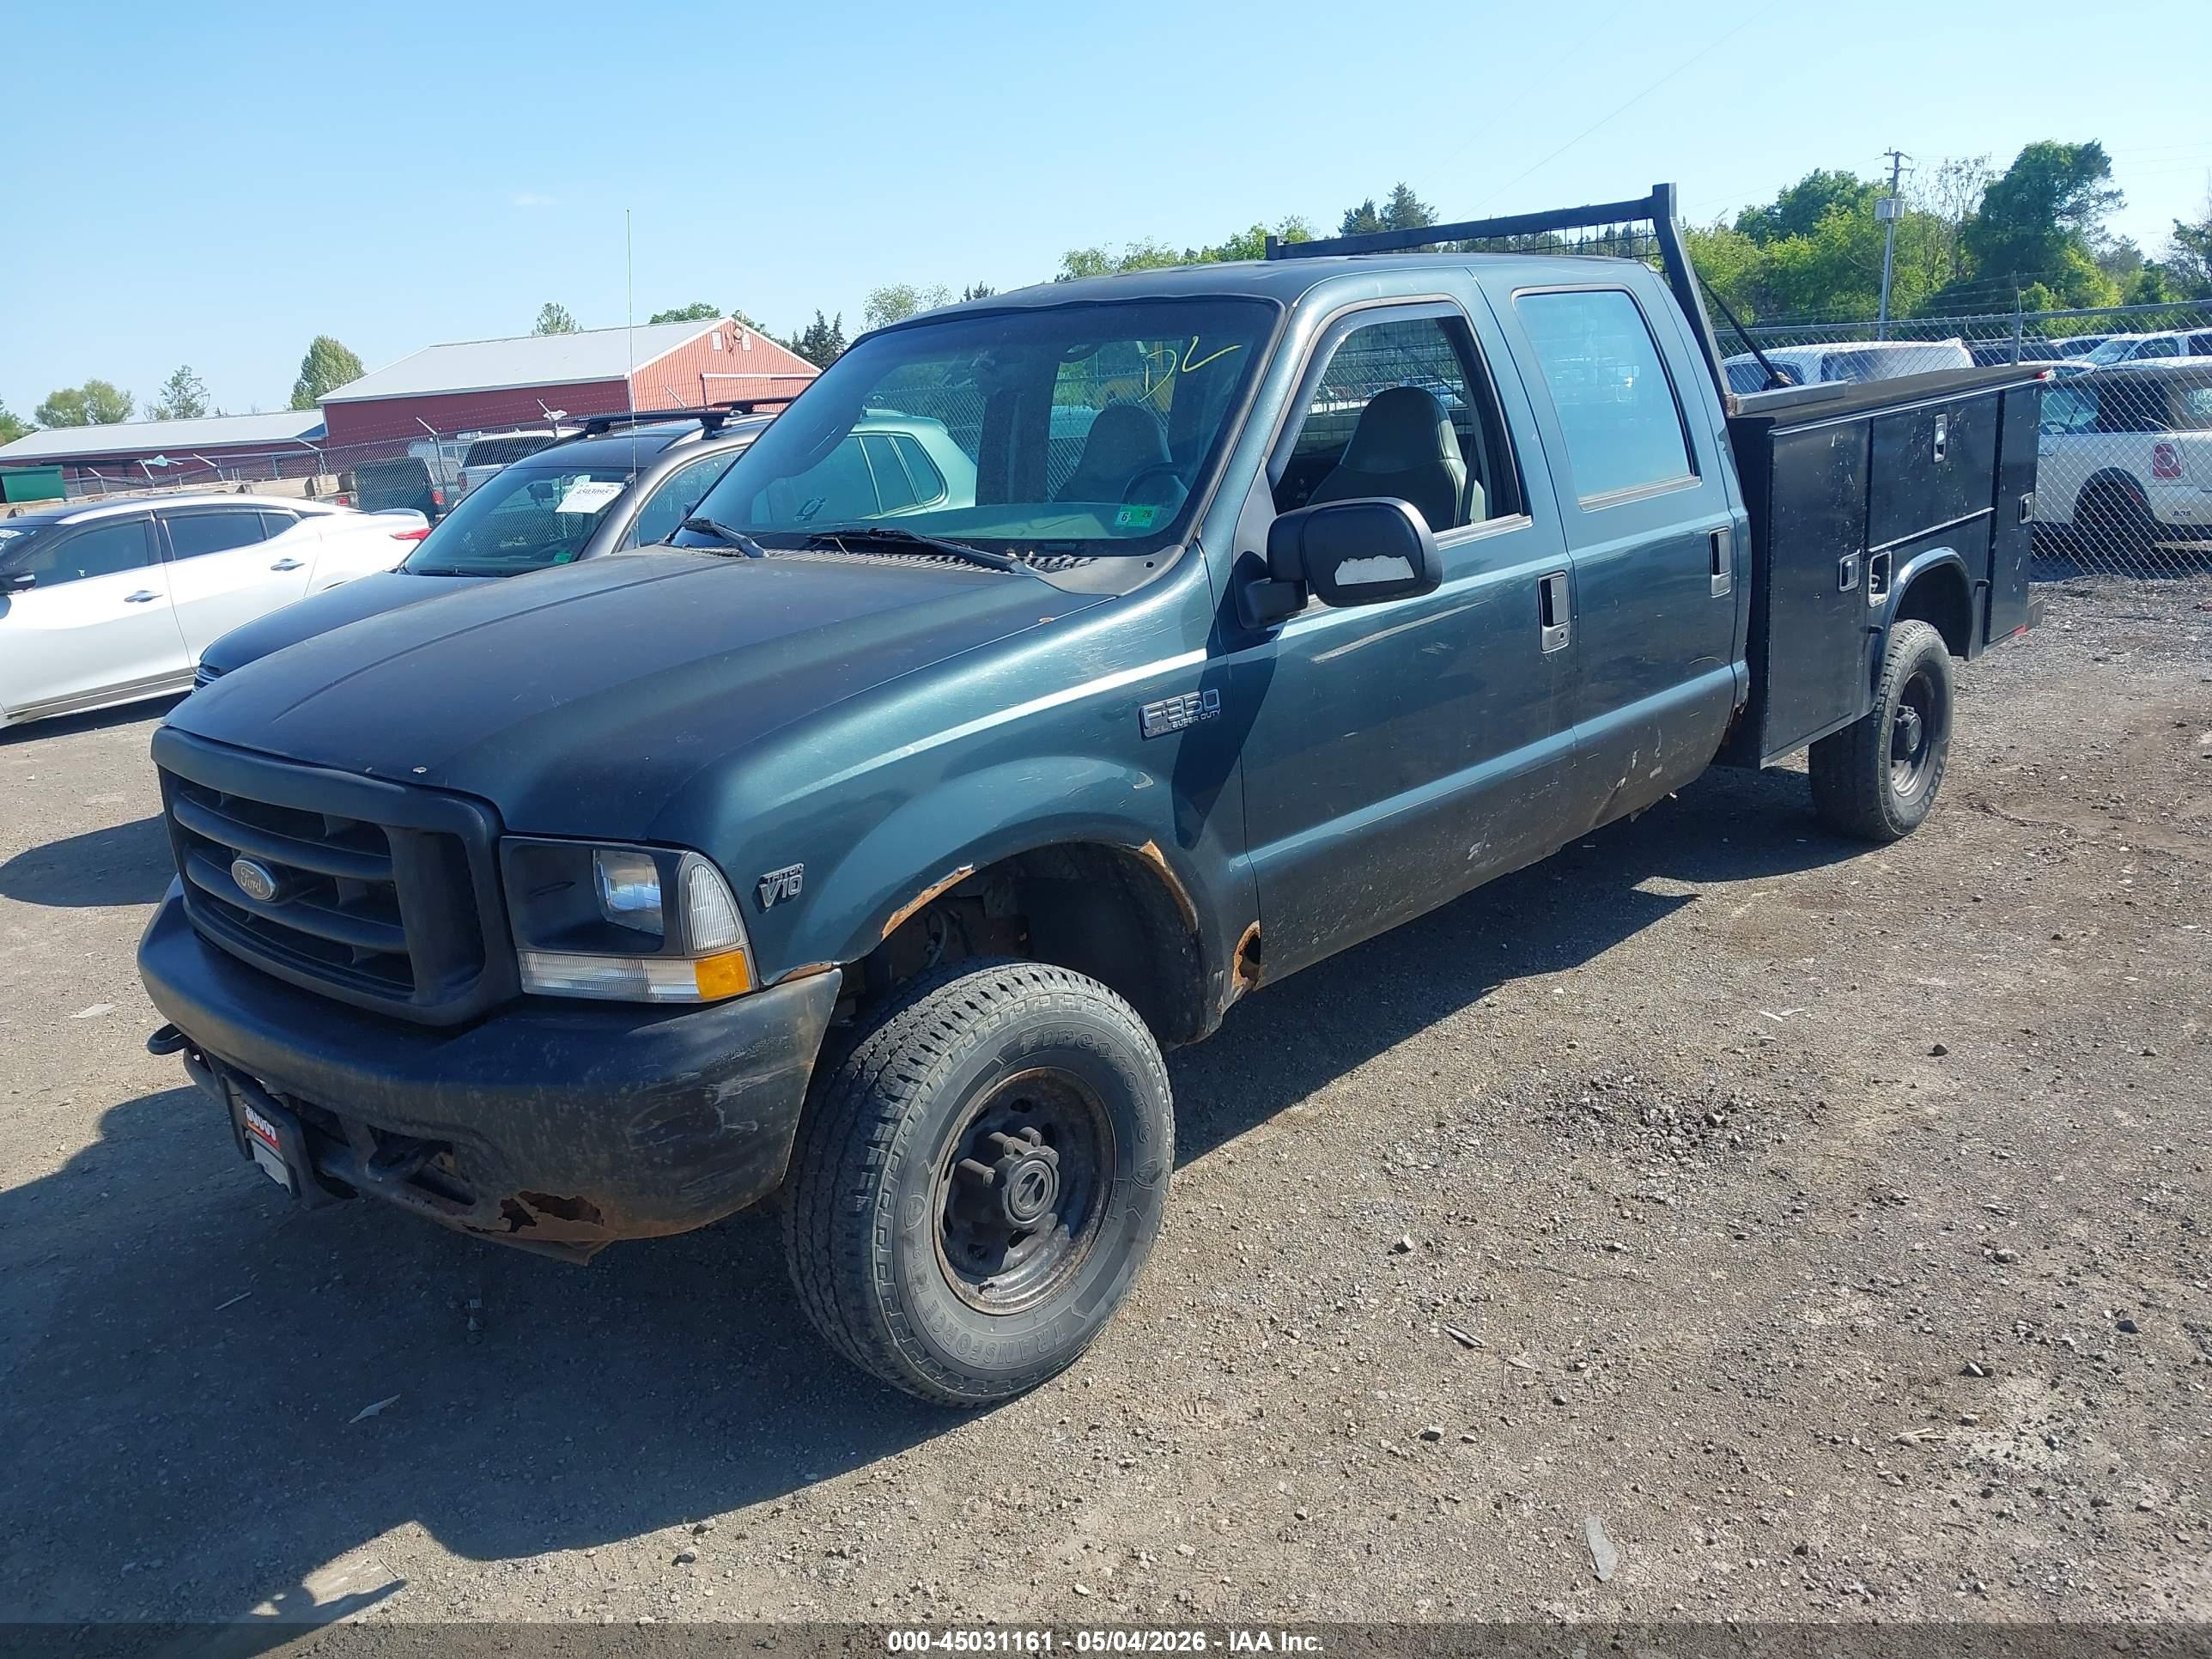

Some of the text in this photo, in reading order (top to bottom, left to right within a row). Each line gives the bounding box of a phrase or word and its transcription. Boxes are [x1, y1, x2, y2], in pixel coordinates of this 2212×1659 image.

[1121, 512, 1129, 522] 6
[1141, 509, 1153, 518] 26
[1171, 716, 1200, 729] SUPER
[1200, 709, 1221, 721] DUTY
[240, 866, 262, 893] Ford
[764, 866, 804, 884] TRITON
[759, 875, 803, 908] V10
[1018, 1029, 1152, 1144] Firestone
[922, 1298, 1066, 1364] TRANSFORCE
